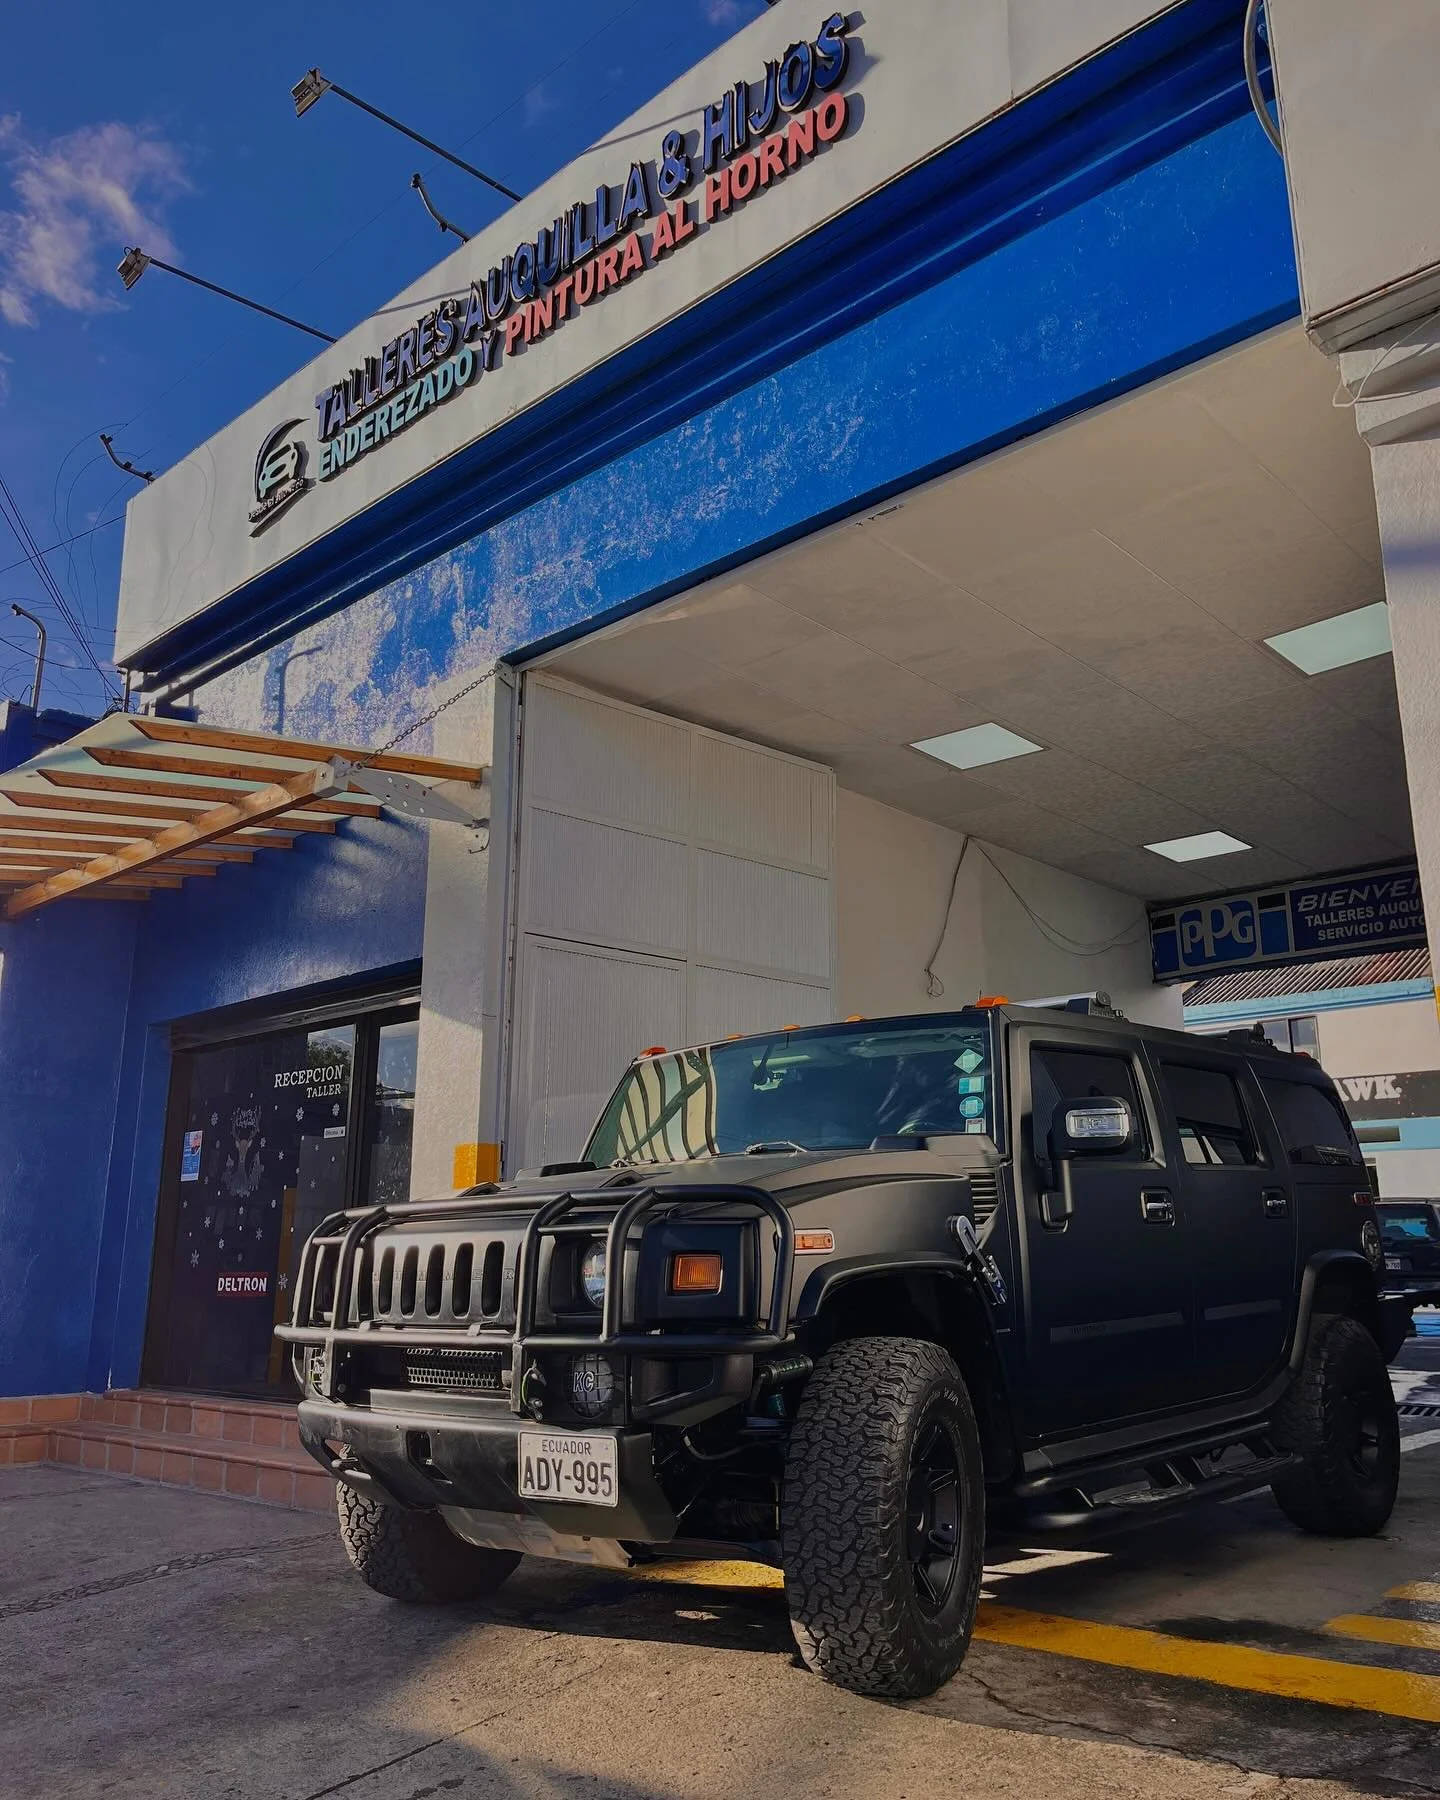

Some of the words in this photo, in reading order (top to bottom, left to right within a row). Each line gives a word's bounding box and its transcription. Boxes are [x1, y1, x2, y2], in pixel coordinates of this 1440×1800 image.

[315, 299, 456, 442] TALLERES
[463, 160, 648, 343] AUQUILLA
[658, 130, 691, 198] &
[703, 12, 849, 173] HIJOS
[318, 346, 474, 481] ENDEREZADO
[481, 328, 499, 371] Y
[505, 231, 645, 355] PINTURA
[650, 199, 696, 260] AL
[705, 92, 848, 223] HORNO
[1305, 905, 1375, 928] TALLERES
[1318, 921, 1384, 941] SERVICIO
[274, 1064, 343, 1088] RECEPCION
[306, 1083, 342, 1098] TALLER
[217, 1277, 267, 1292] DELTRON
[573, 1371, 595, 1393] KC
[542, 1439, 591, 1455] ECUADOR
[523, 1455, 612, 1497] ADY-995
